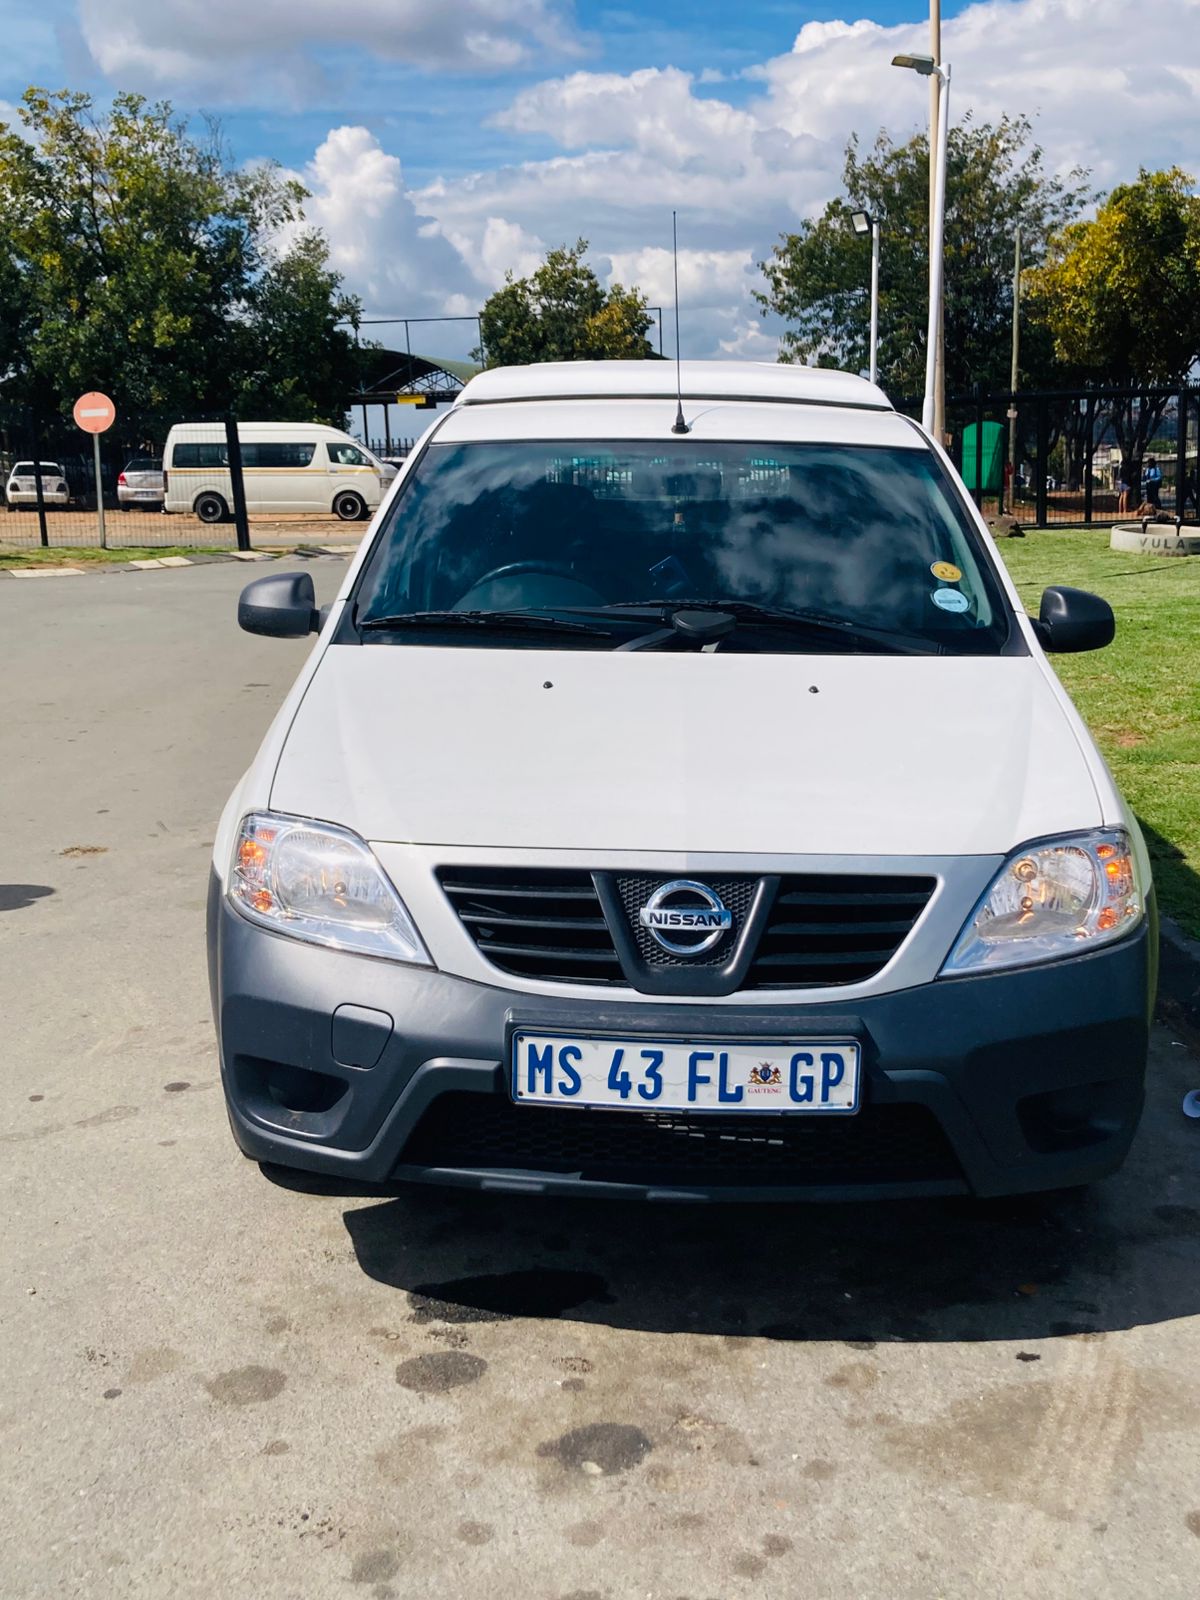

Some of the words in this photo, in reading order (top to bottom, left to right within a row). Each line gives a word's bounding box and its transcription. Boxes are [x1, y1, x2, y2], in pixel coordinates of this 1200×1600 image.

[649, 912, 722, 926] NISSAN
[527, 1043, 582, 1096] MS
[607, 1048, 664, 1100] 43
[688, 1051, 743, 1102] FL
[789, 1052, 845, 1102] GP
